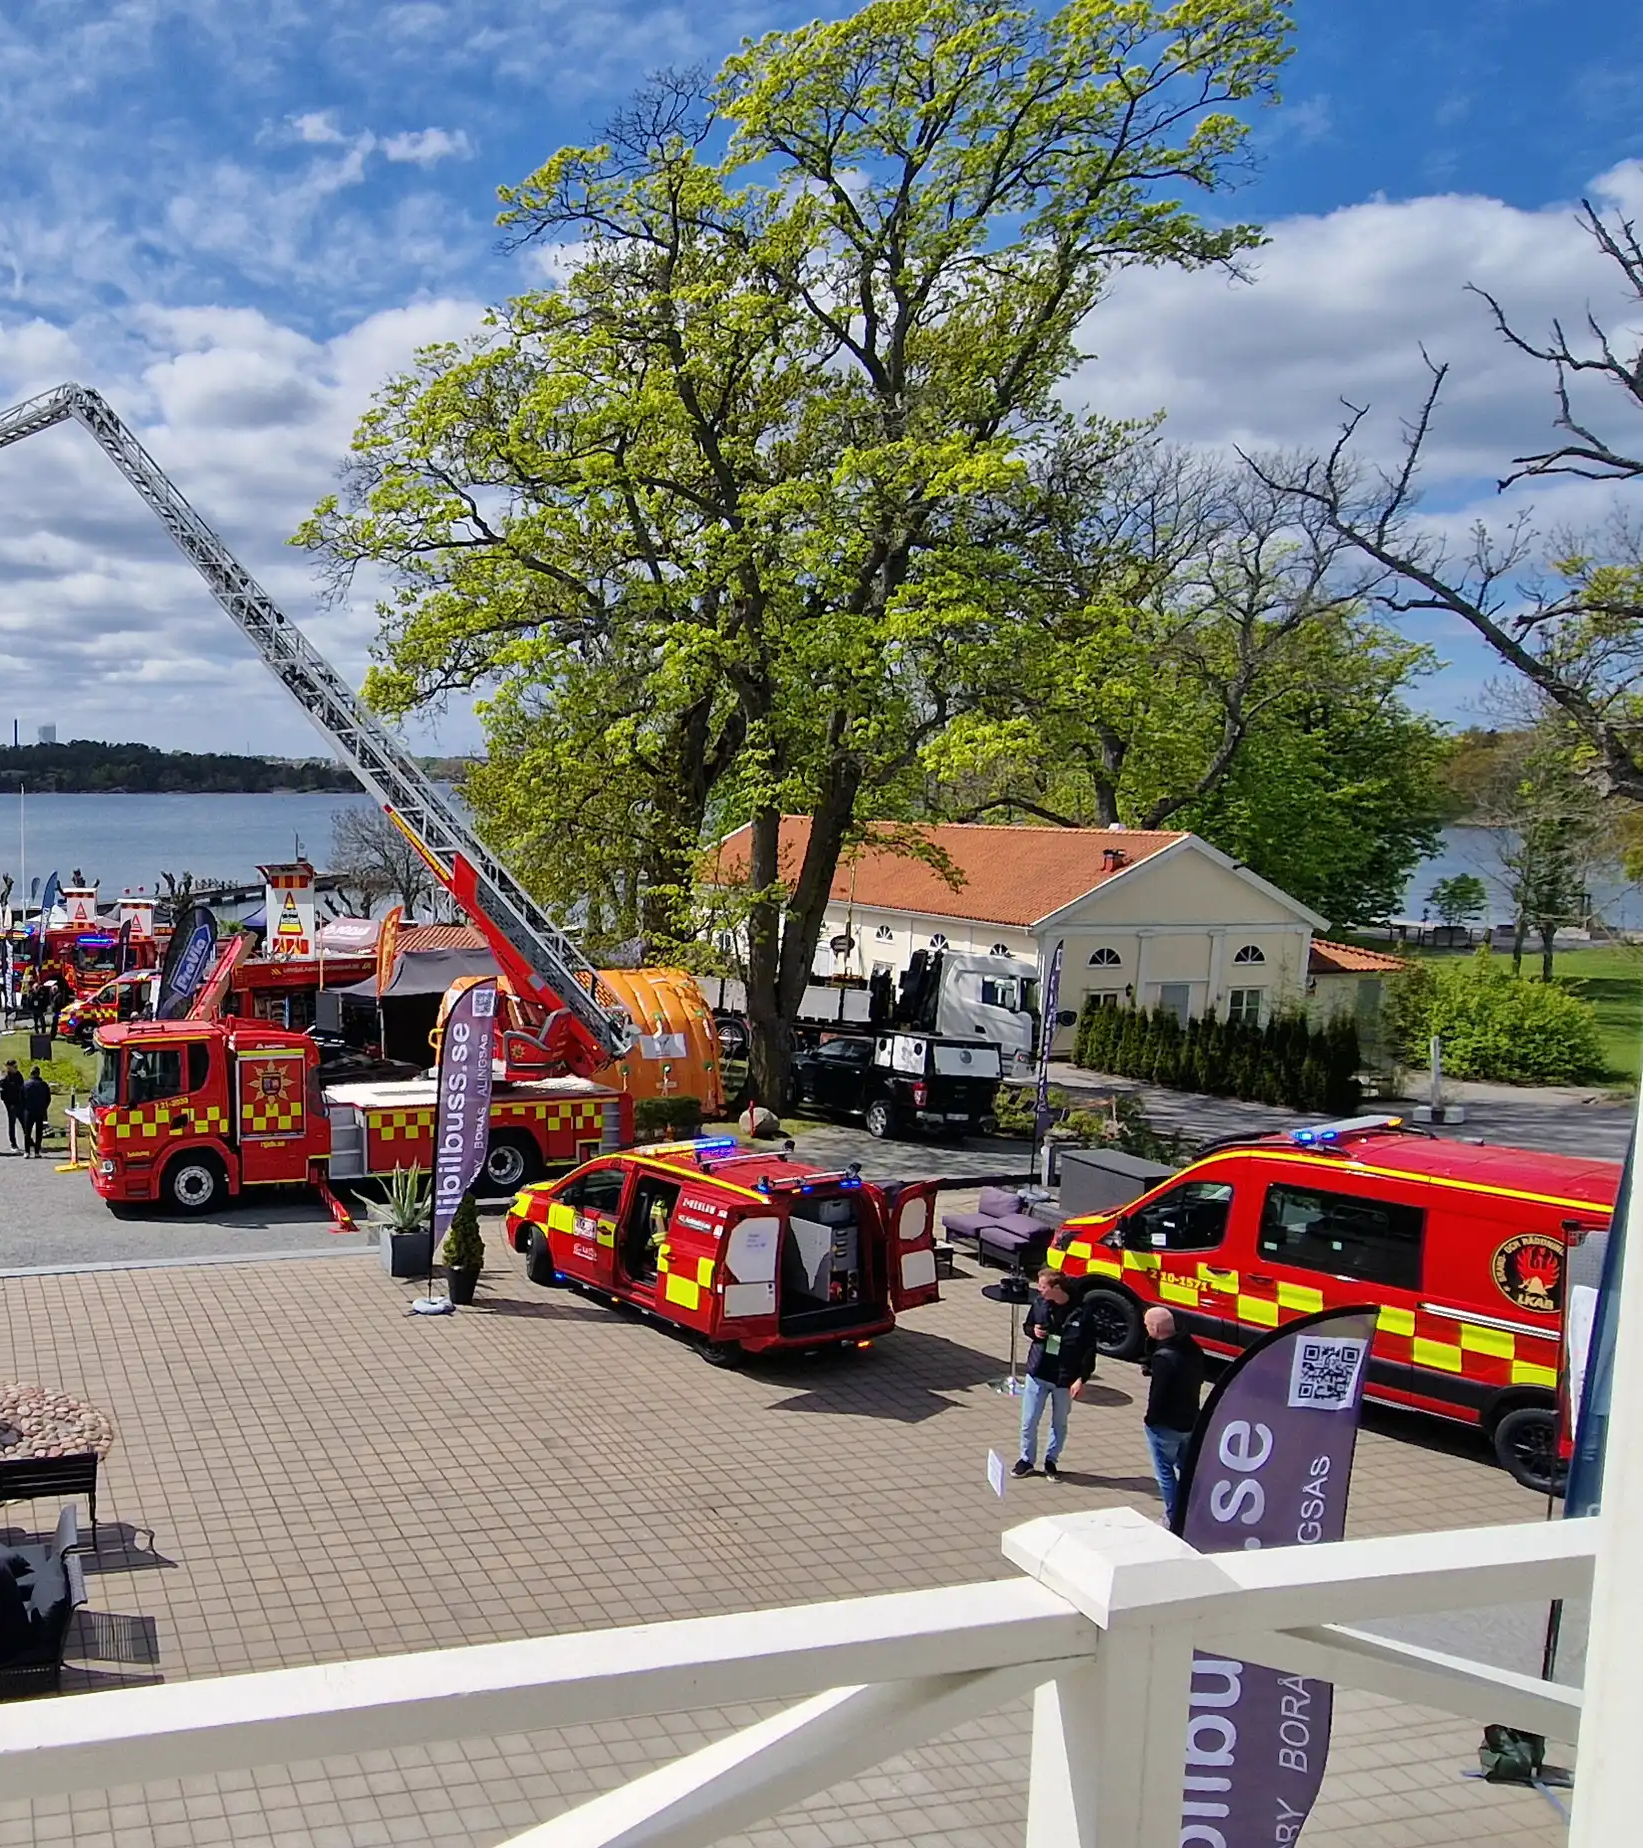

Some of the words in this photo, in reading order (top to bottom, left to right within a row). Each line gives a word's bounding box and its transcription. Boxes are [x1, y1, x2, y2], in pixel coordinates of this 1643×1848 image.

[1503, 1240, 1521, 1254] OCH
[1160, 1271, 1208, 1292] 10-1571
[1518, 1292, 1554, 1310] LKAB
[1277, 1675, 1312, 1773] BORÅ
[1297, 1455, 1331, 1544] GSÅS
